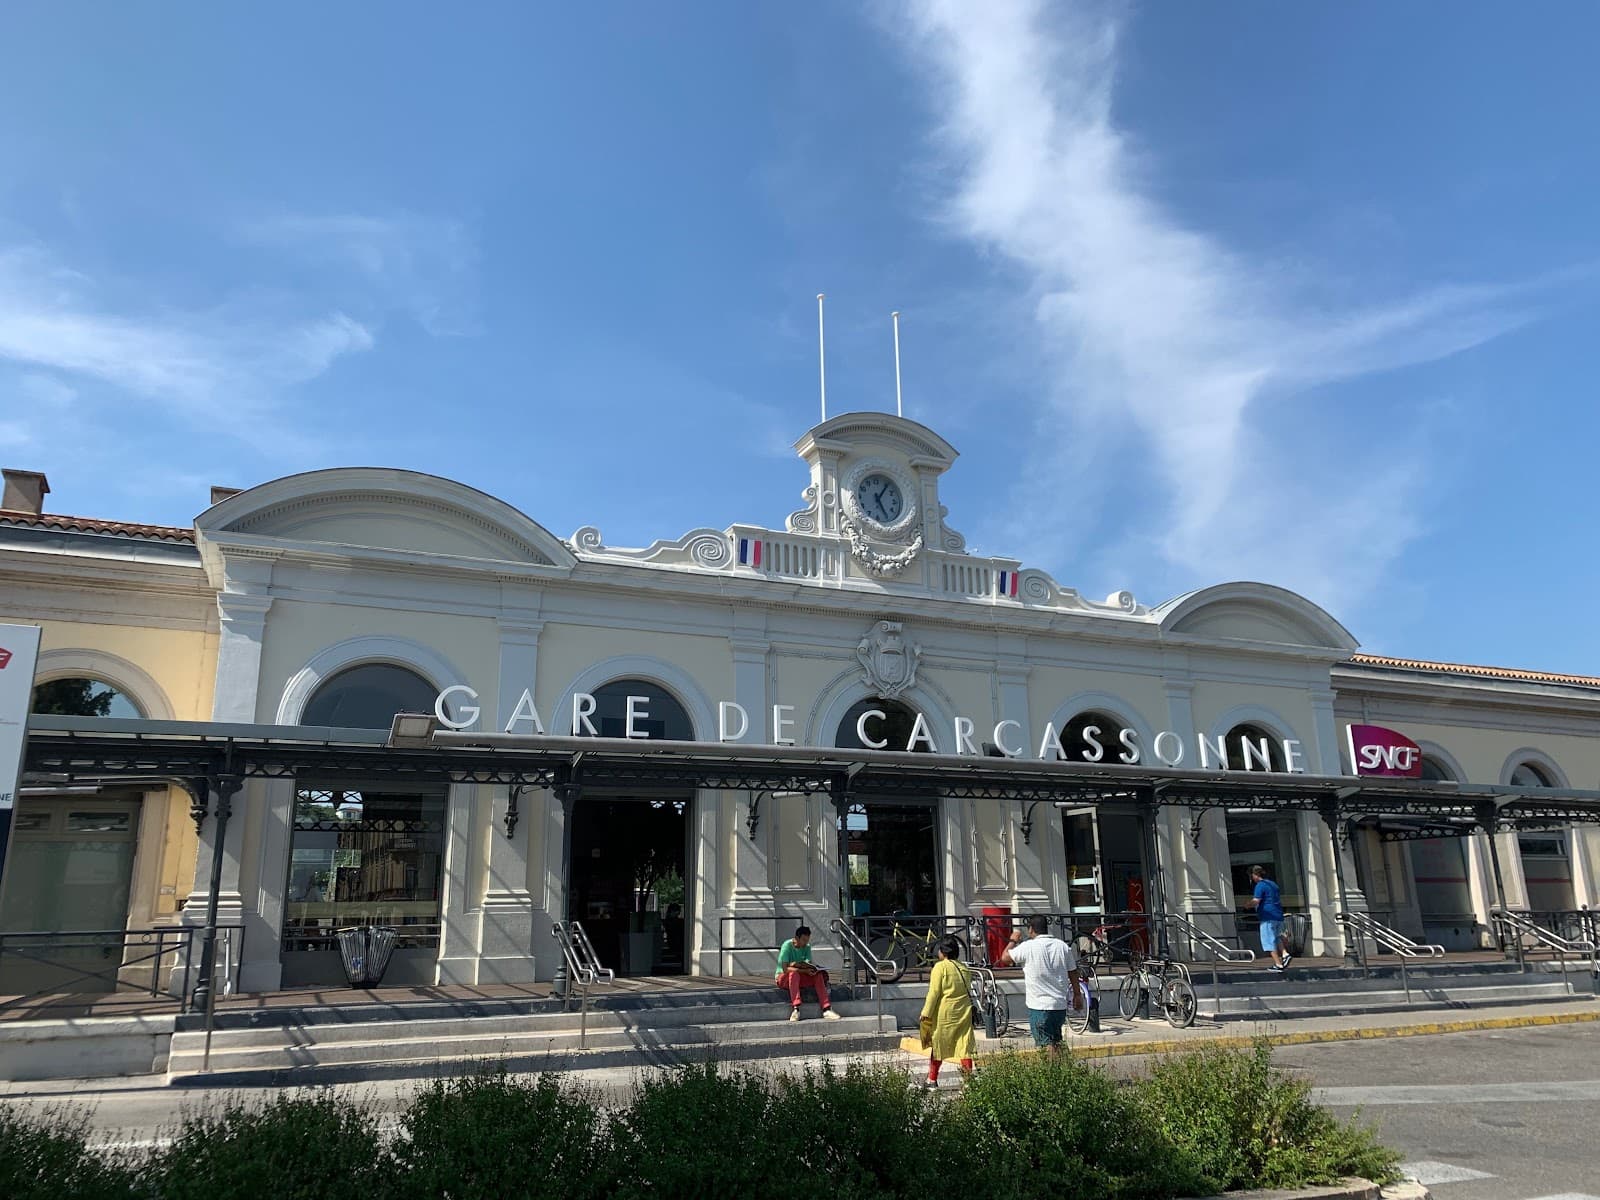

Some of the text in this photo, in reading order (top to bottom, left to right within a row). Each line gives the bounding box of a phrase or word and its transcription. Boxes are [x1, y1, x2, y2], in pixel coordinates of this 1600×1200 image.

[434, 684, 1304, 774] GARE DE CARCASSONNE
[1359, 744, 1420, 770] SNCF
